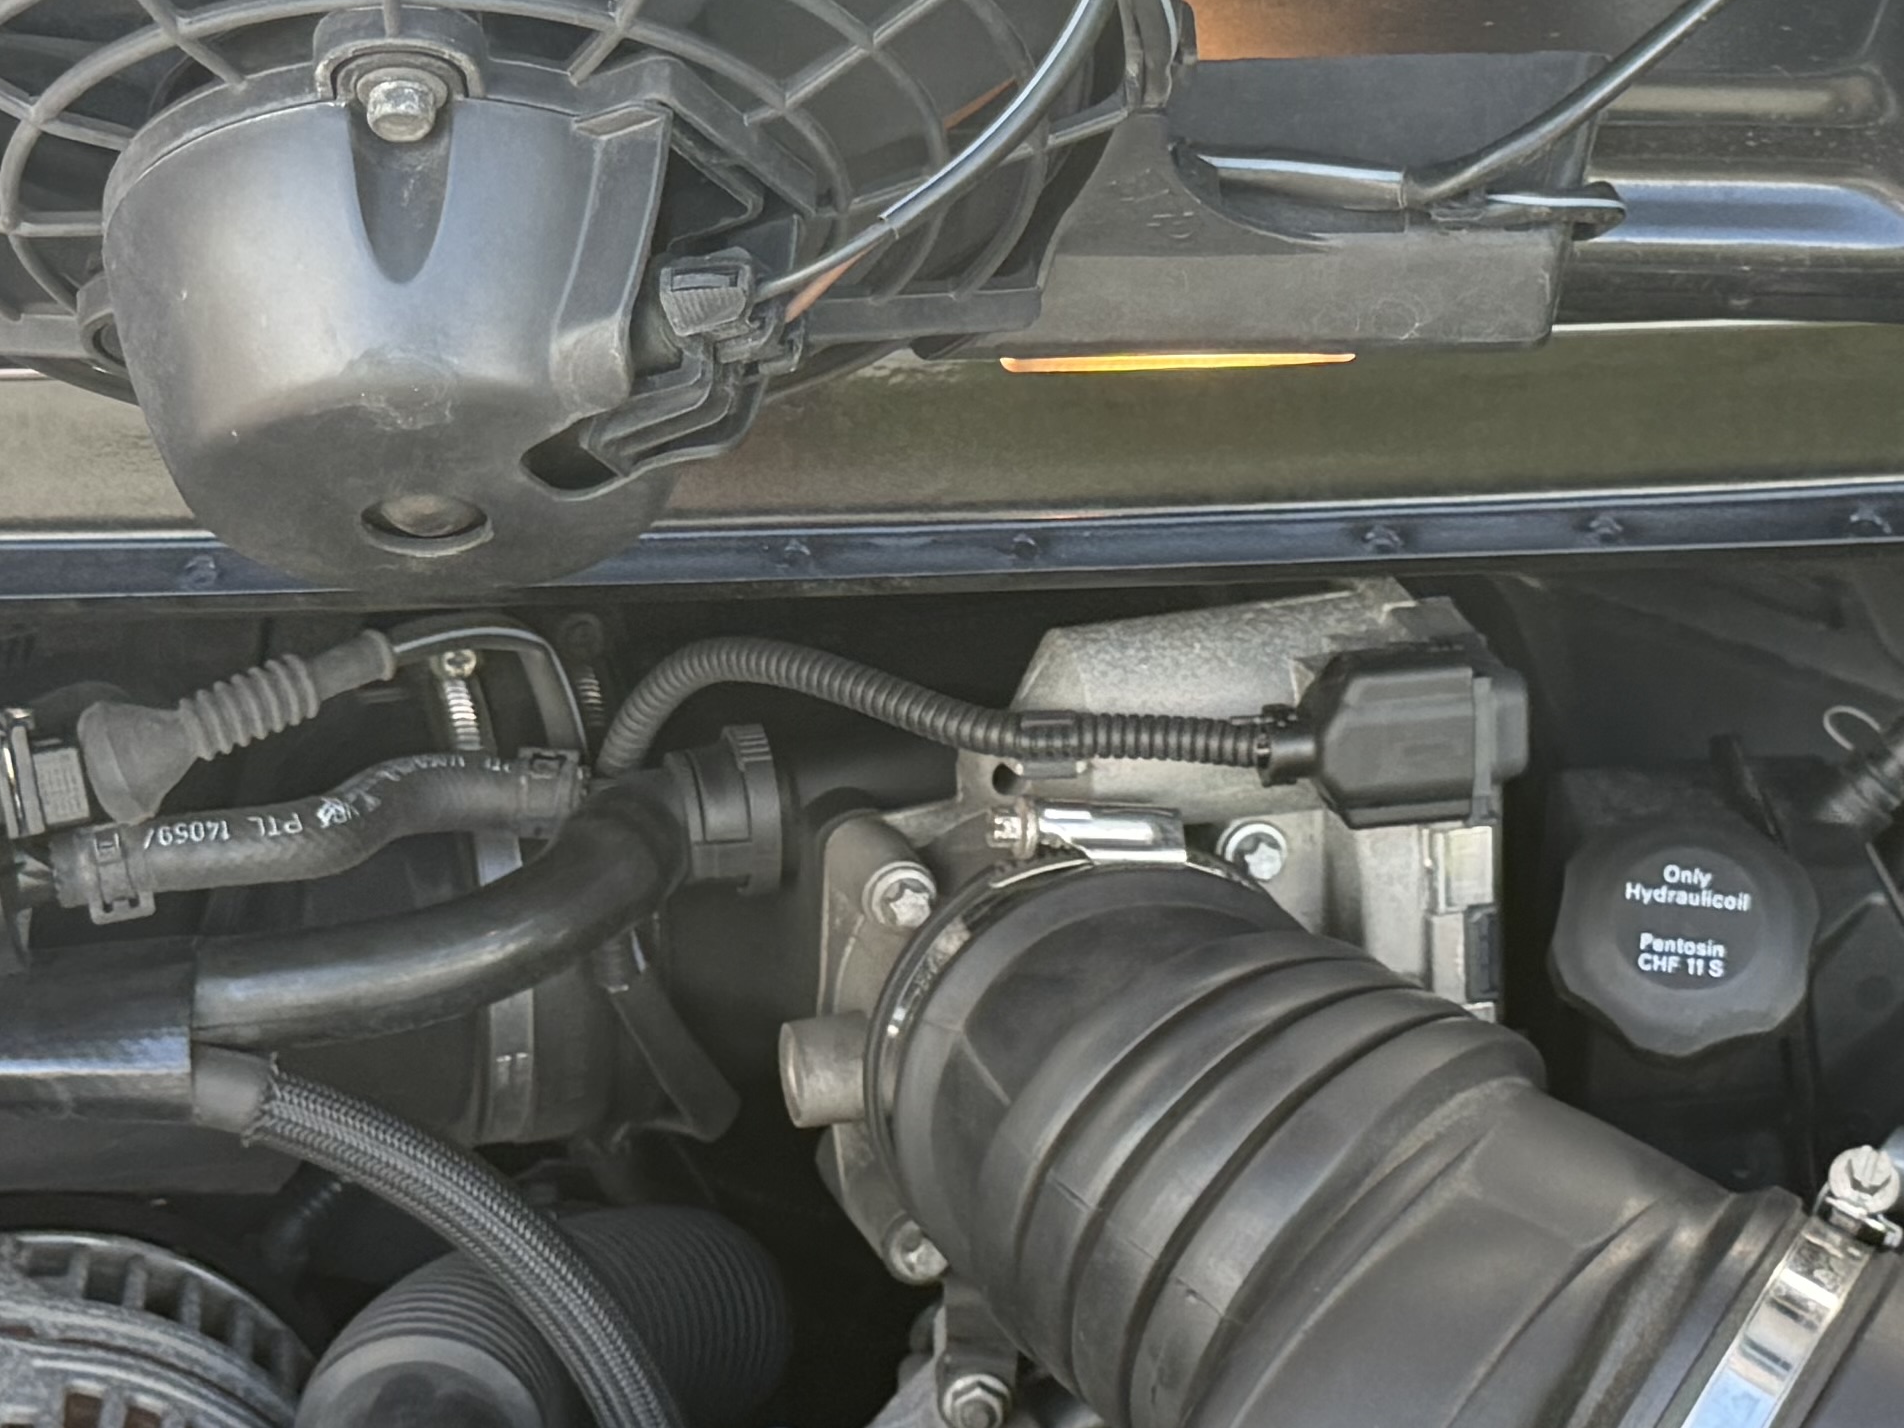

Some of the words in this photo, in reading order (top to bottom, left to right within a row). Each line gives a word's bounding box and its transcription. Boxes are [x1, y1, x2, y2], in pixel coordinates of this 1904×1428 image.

[1663, 864, 1712, 888] Only
[1625, 882, 1752, 912] Hydraulicoil
[1639, 932, 1727, 958] Pentosin
[1637, 953, 1681, 973] CHF
[1686, 960, 1704, 976] 11
[1708, 960, 1725, 978] S
